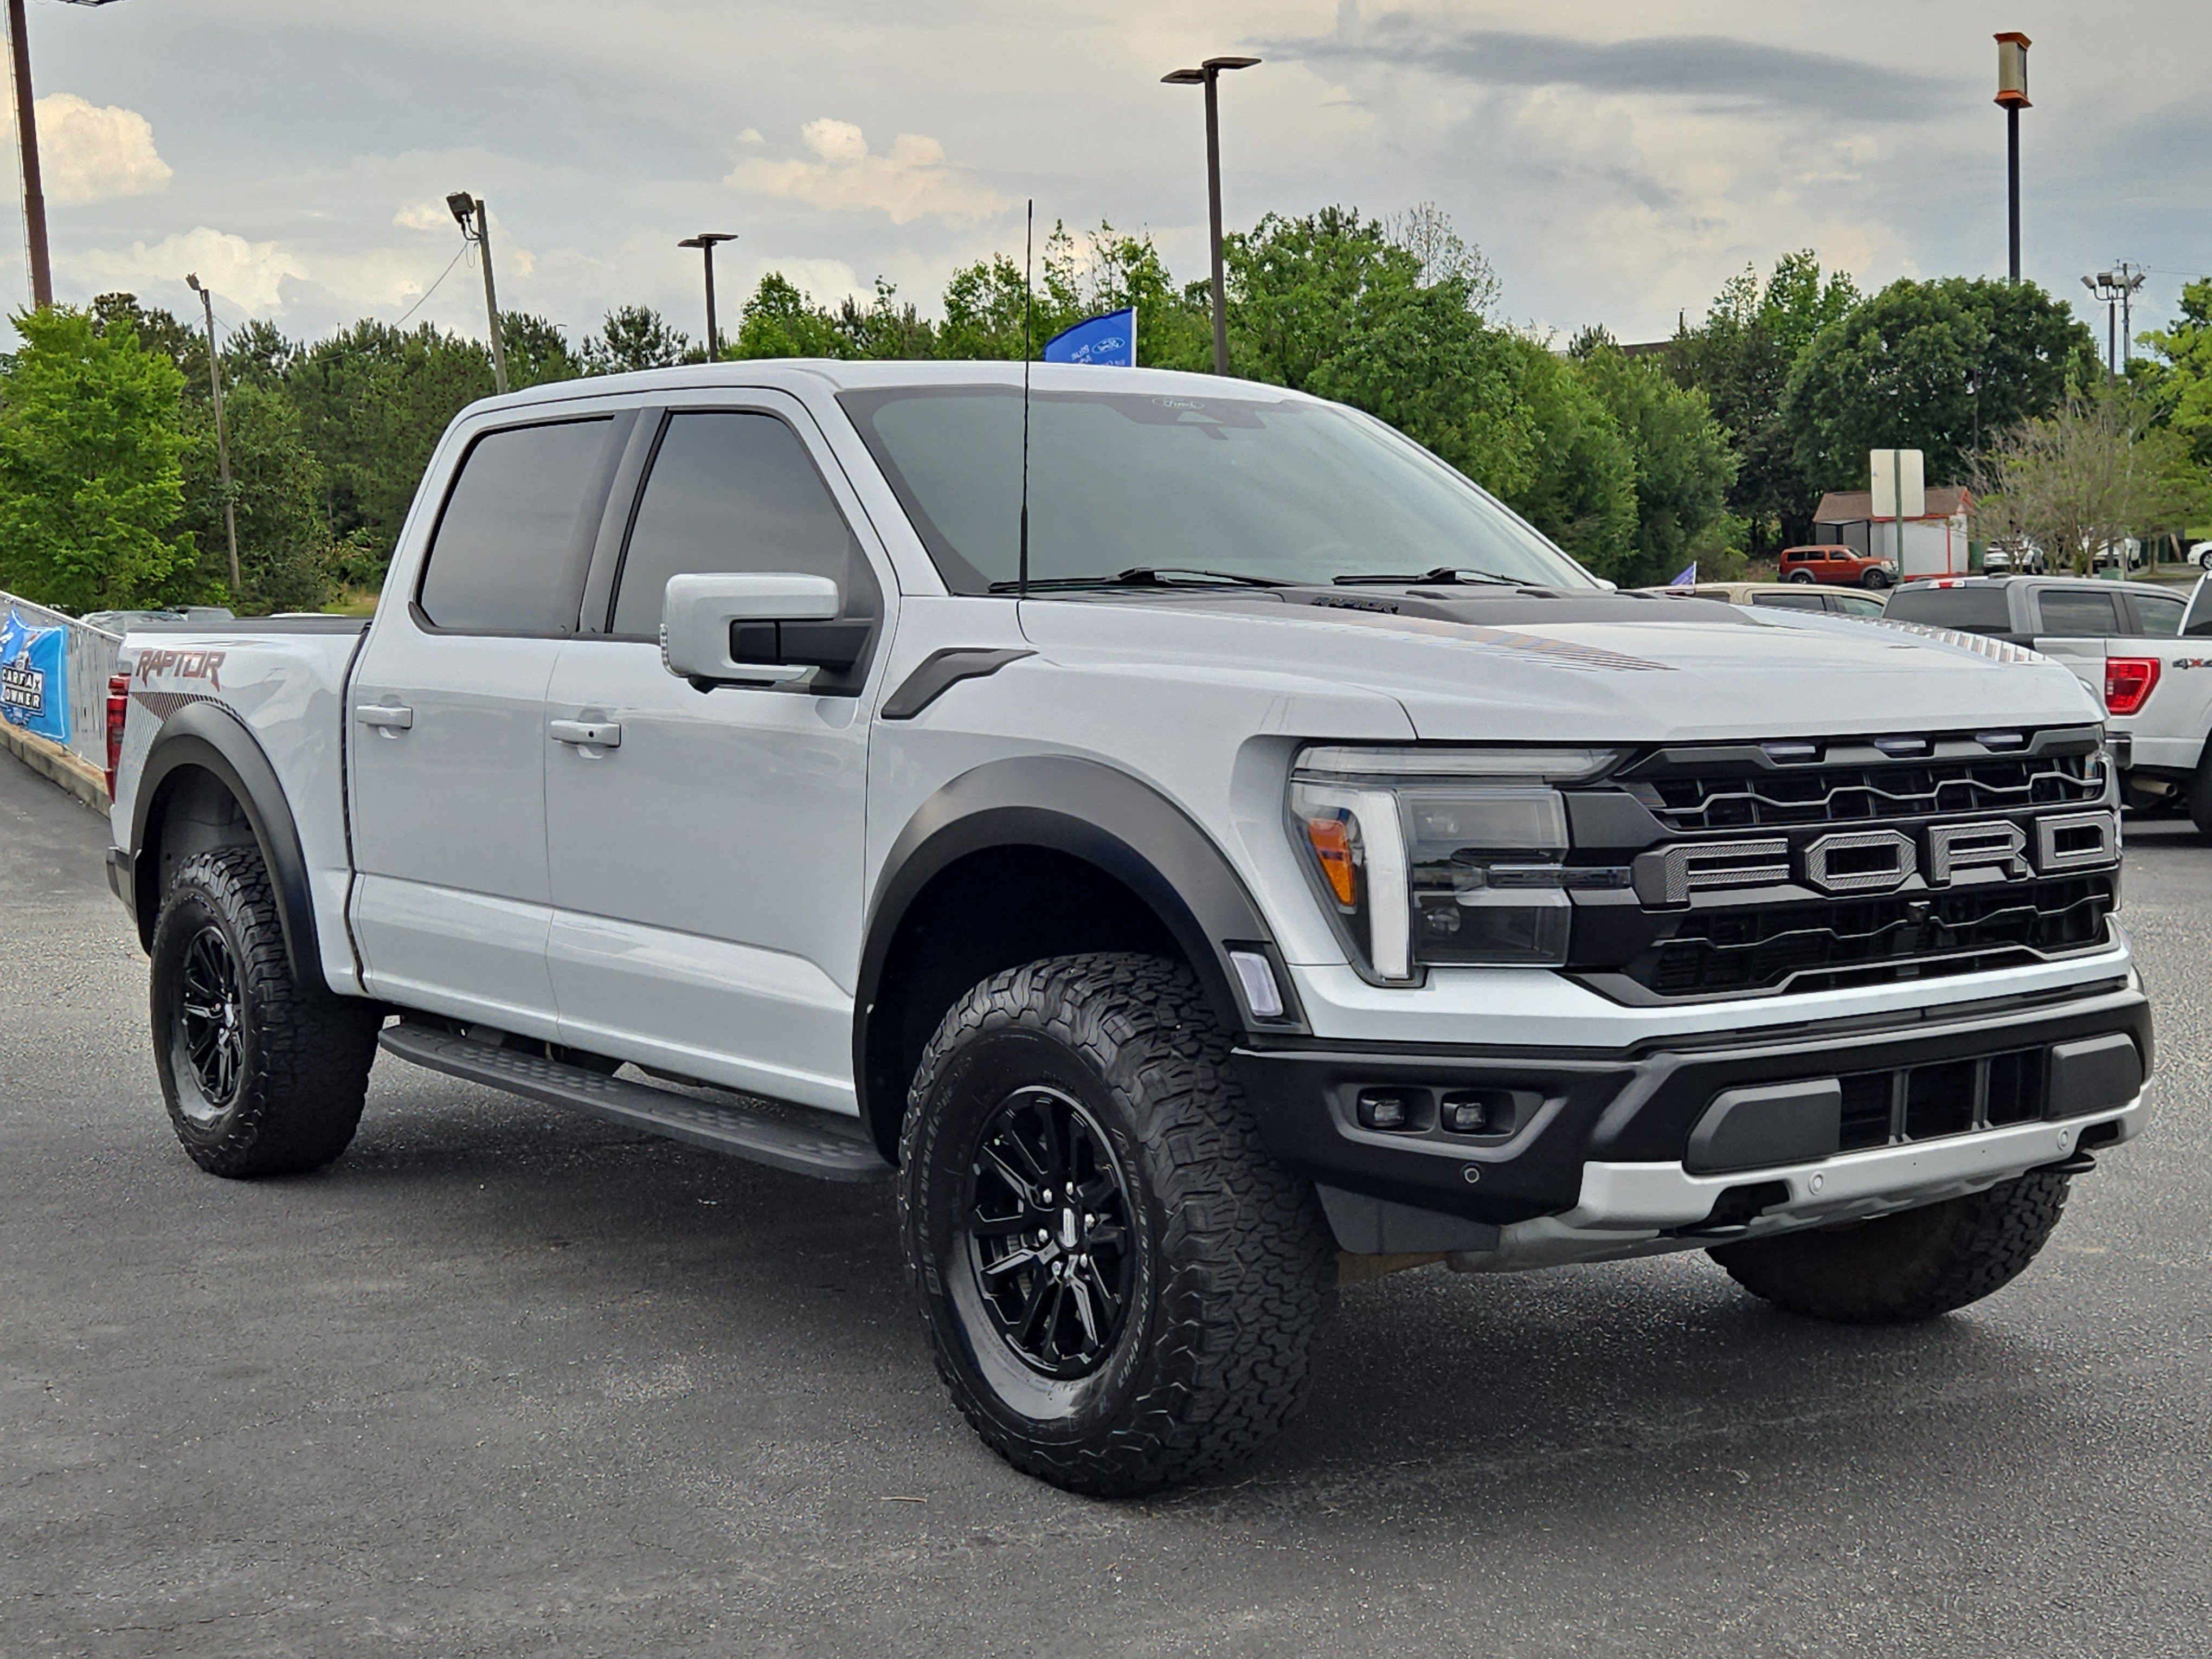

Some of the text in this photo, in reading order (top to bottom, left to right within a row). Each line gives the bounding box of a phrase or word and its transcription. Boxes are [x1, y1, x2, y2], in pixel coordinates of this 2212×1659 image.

[2, 668, 41, 691] CARFAX
[136, 650, 226, 692] RAPTOR
[1662, 809, 2118, 908] FORD
